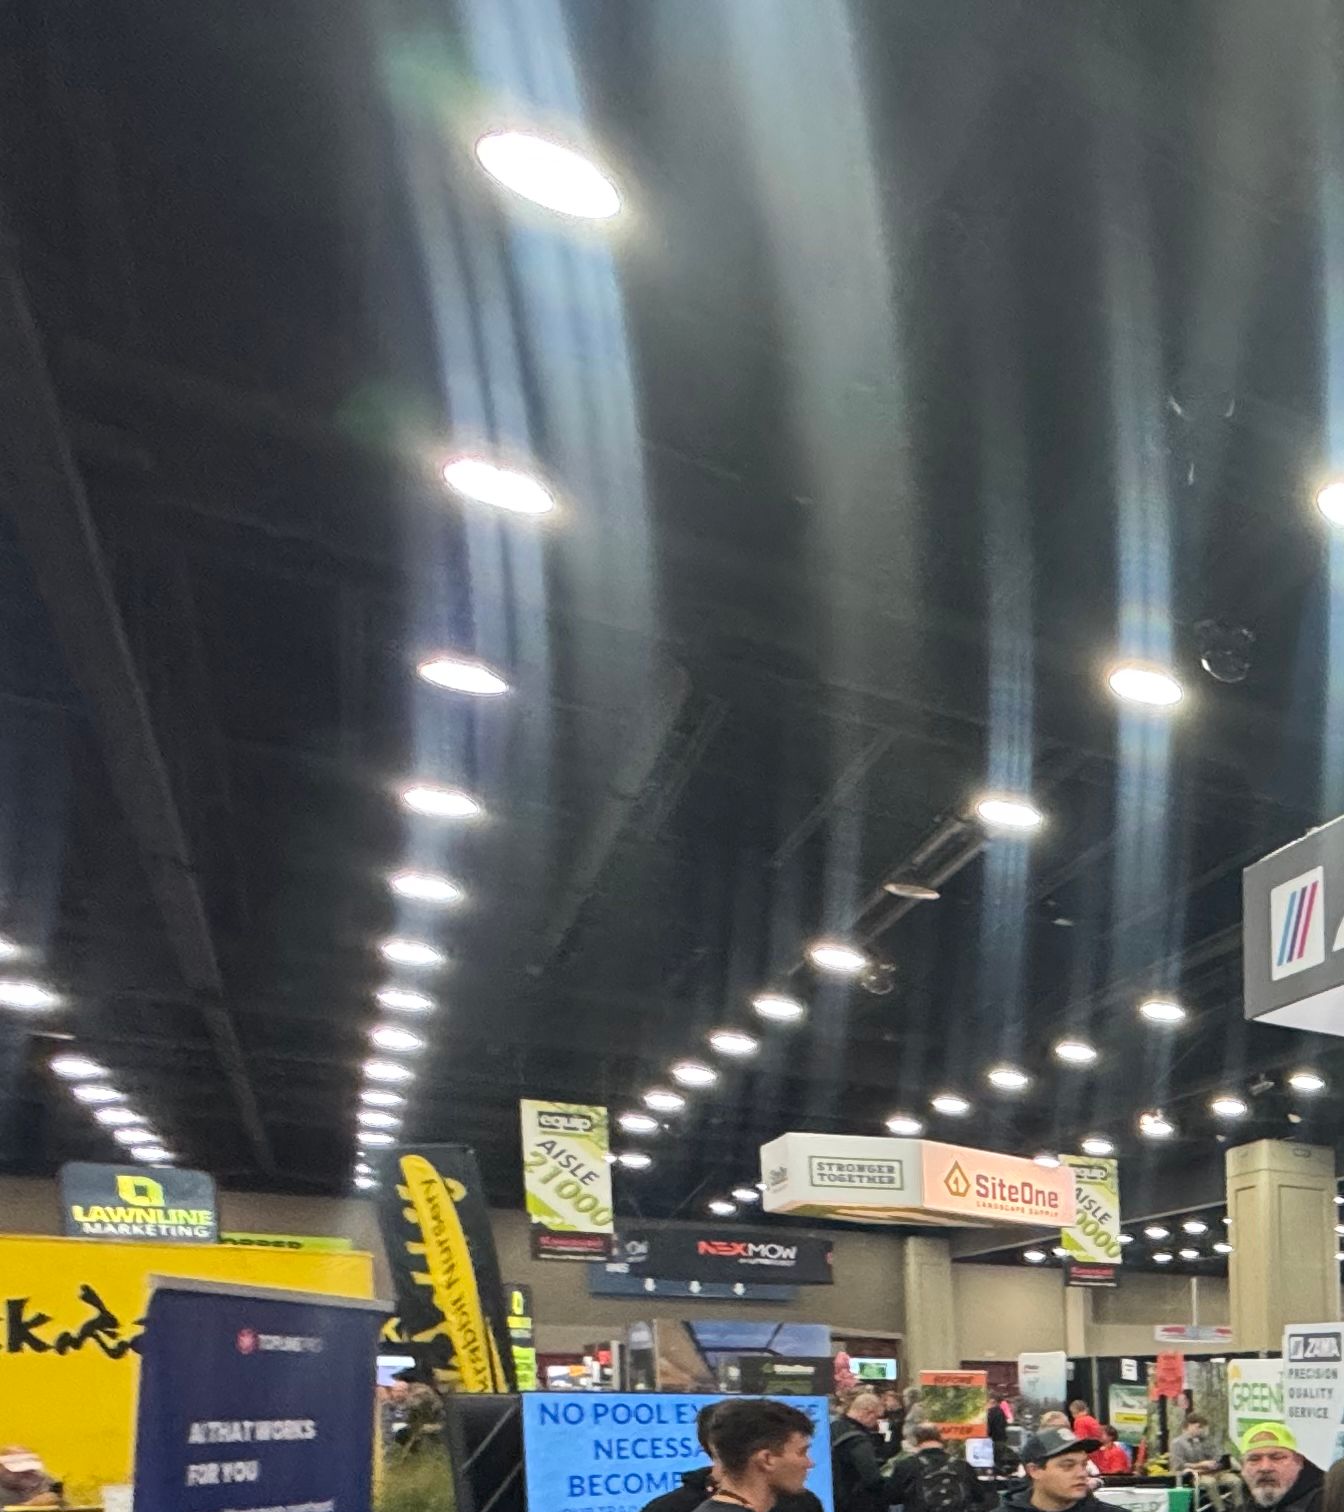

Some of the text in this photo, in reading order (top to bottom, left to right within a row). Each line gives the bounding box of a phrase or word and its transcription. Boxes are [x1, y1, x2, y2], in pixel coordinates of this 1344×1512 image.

[537, 1140, 600, 1186] AISLE
[816, 1160, 896, 1175] STRONGER
[816, 1172, 896, 1185] TOGETHER
[975, 1173, 1059, 1209] SiteOne
[71, 1205, 213, 1226] LAWNLINE
[81, 1222, 210, 1238] MARKETING
[1287, 1367, 1338, 1380] PRECISION
[1287, 1386, 1334, 1399] QUALITY
[539, 1402, 584, 1426] NO
[593, 1402, 669, 1425] POOL
[1287, 1406, 1329, 1419] SERVICE
[255, 1419, 318, 1441] WORKS
[593, 1437, 702, 1460] NECESSA
[186, 1459, 260, 1487] FOR YOU
